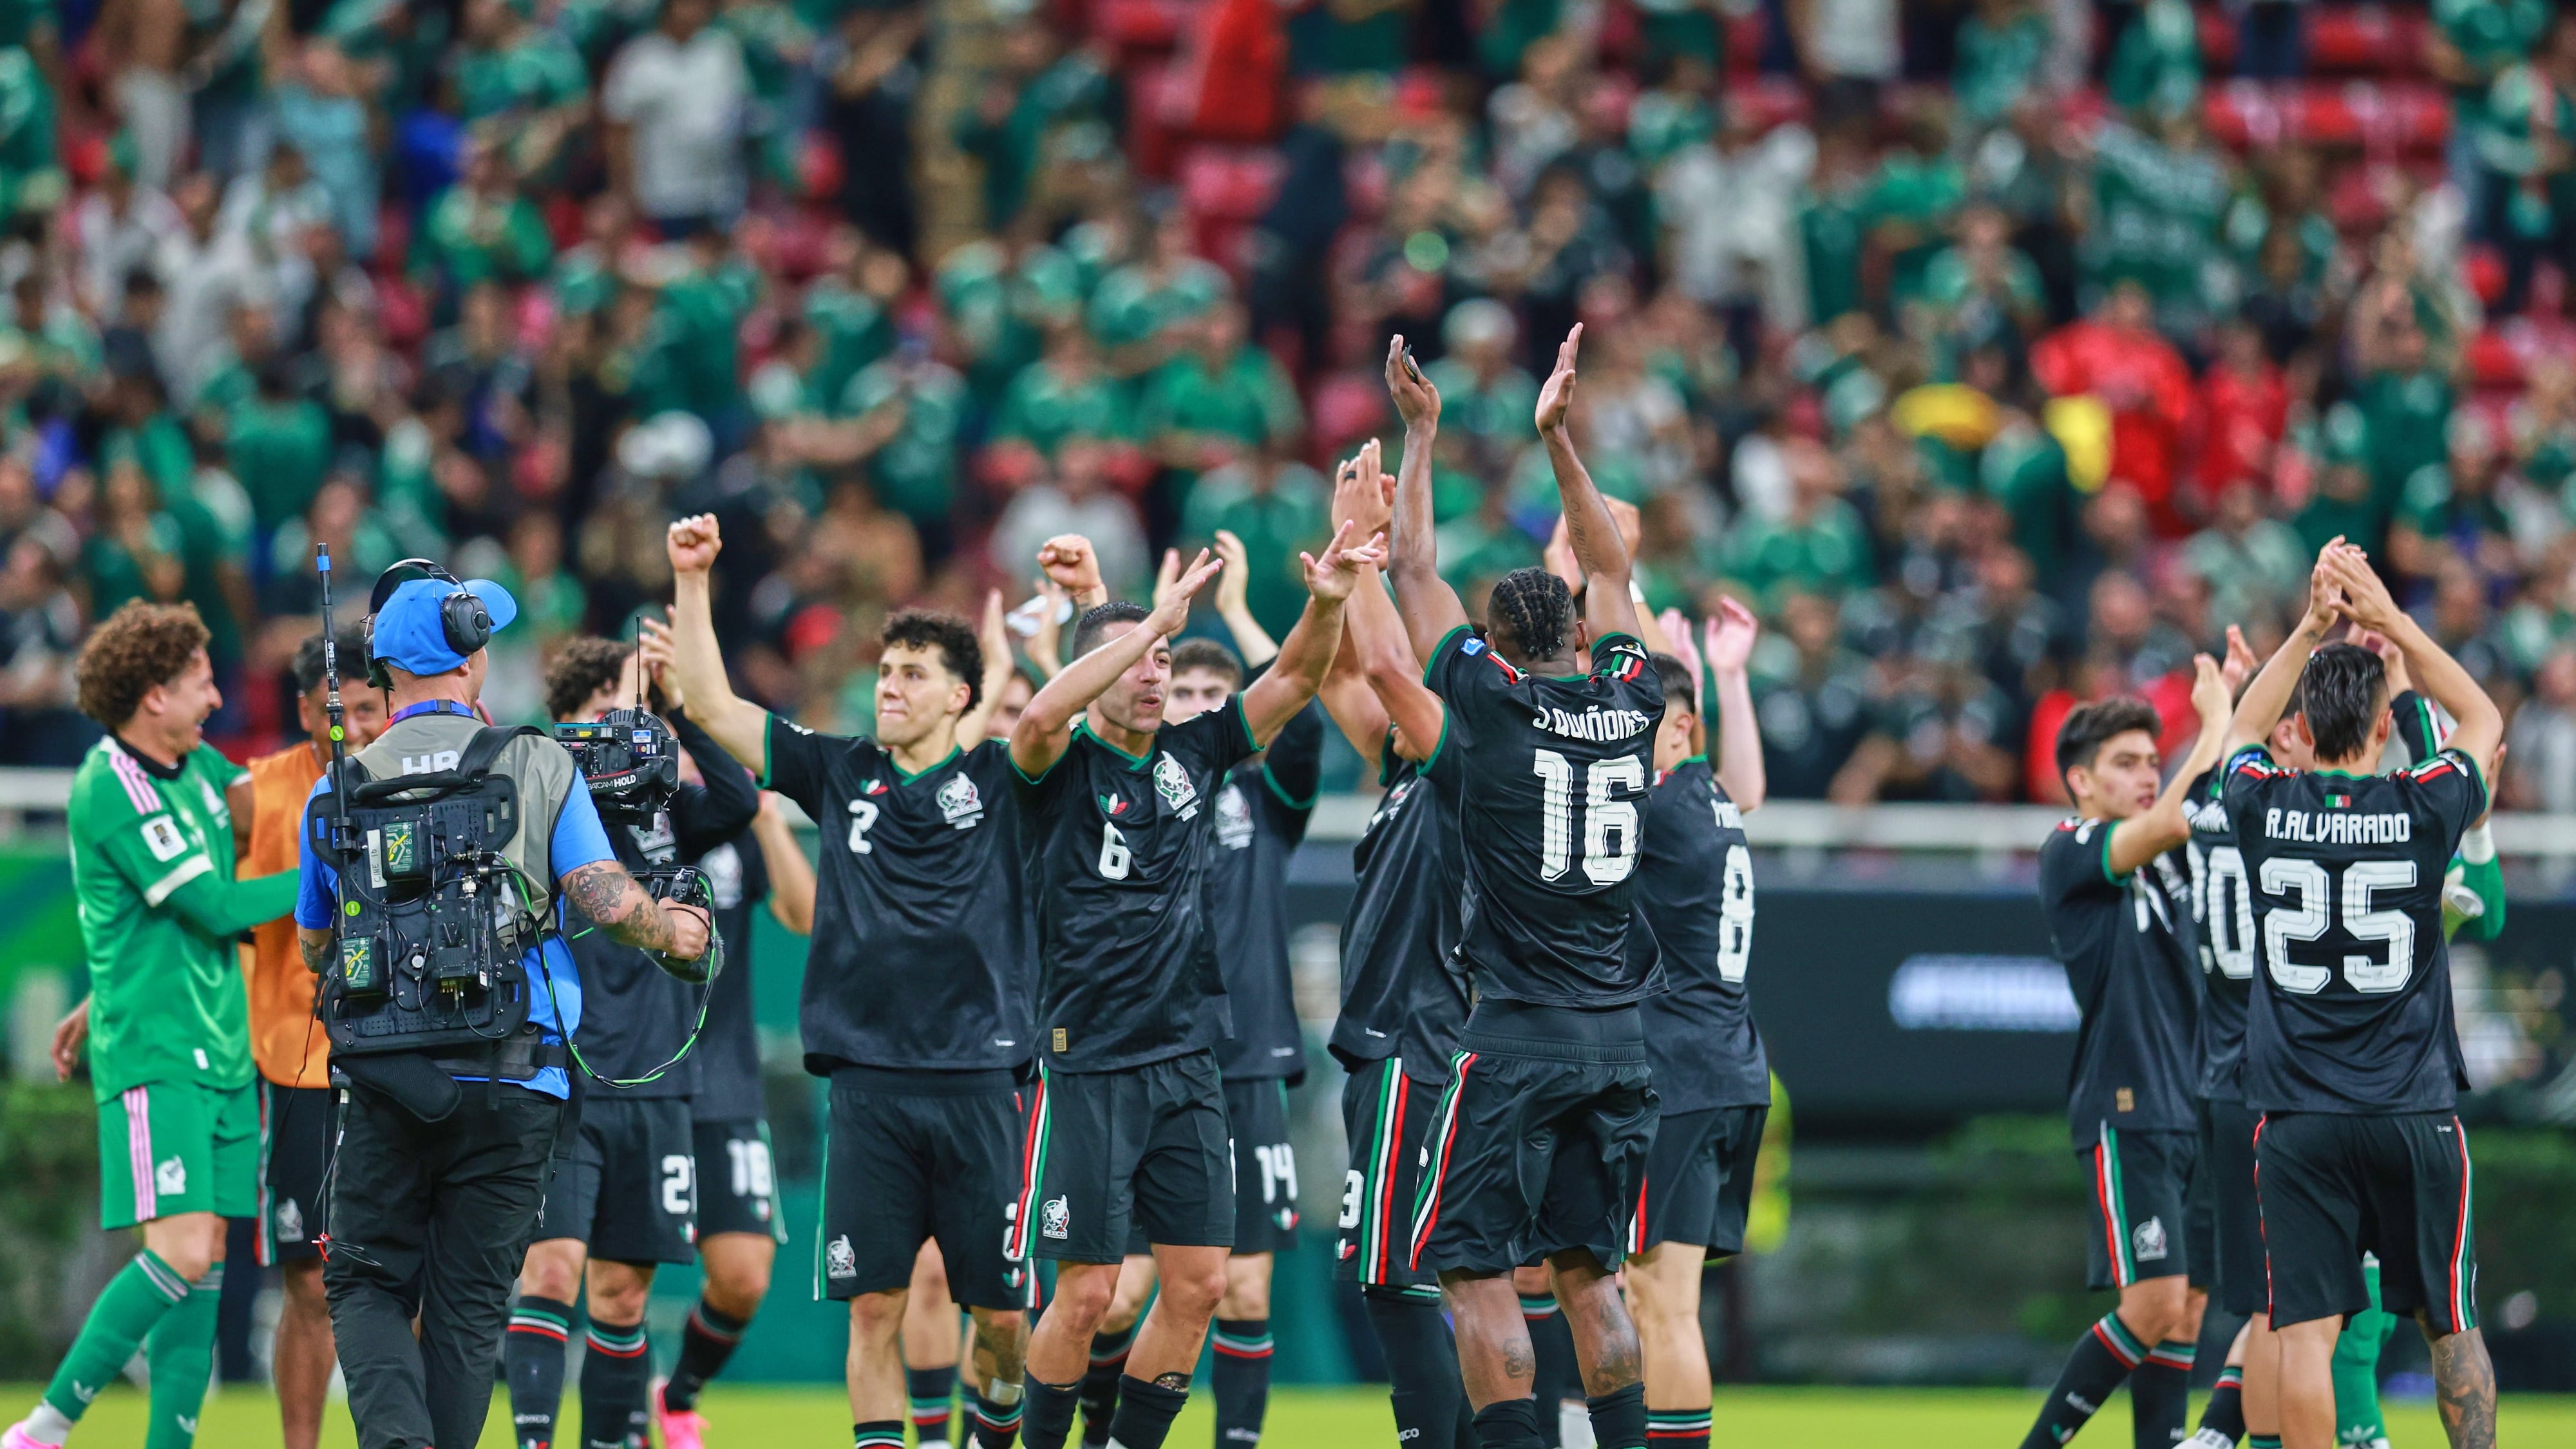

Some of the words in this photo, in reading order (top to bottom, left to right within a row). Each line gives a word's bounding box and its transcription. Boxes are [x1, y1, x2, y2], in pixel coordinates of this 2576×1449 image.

[1532, 705, 1650, 741] J.QUIÑONES
[614, 774, 636, 788] HOLD
[848, 799, 880, 855] 2
[1533, 748, 1645, 886] 16
[2265, 807, 2410, 844] R.ALVARADO
[372, 864, 381, 882] CINE
[1098, 820, 1132, 880] 6
[1717, 844, 1756, 983] 8
[2259, 857, 2417, 994] 25
[1255, 1142, 1298, 1204] 14
